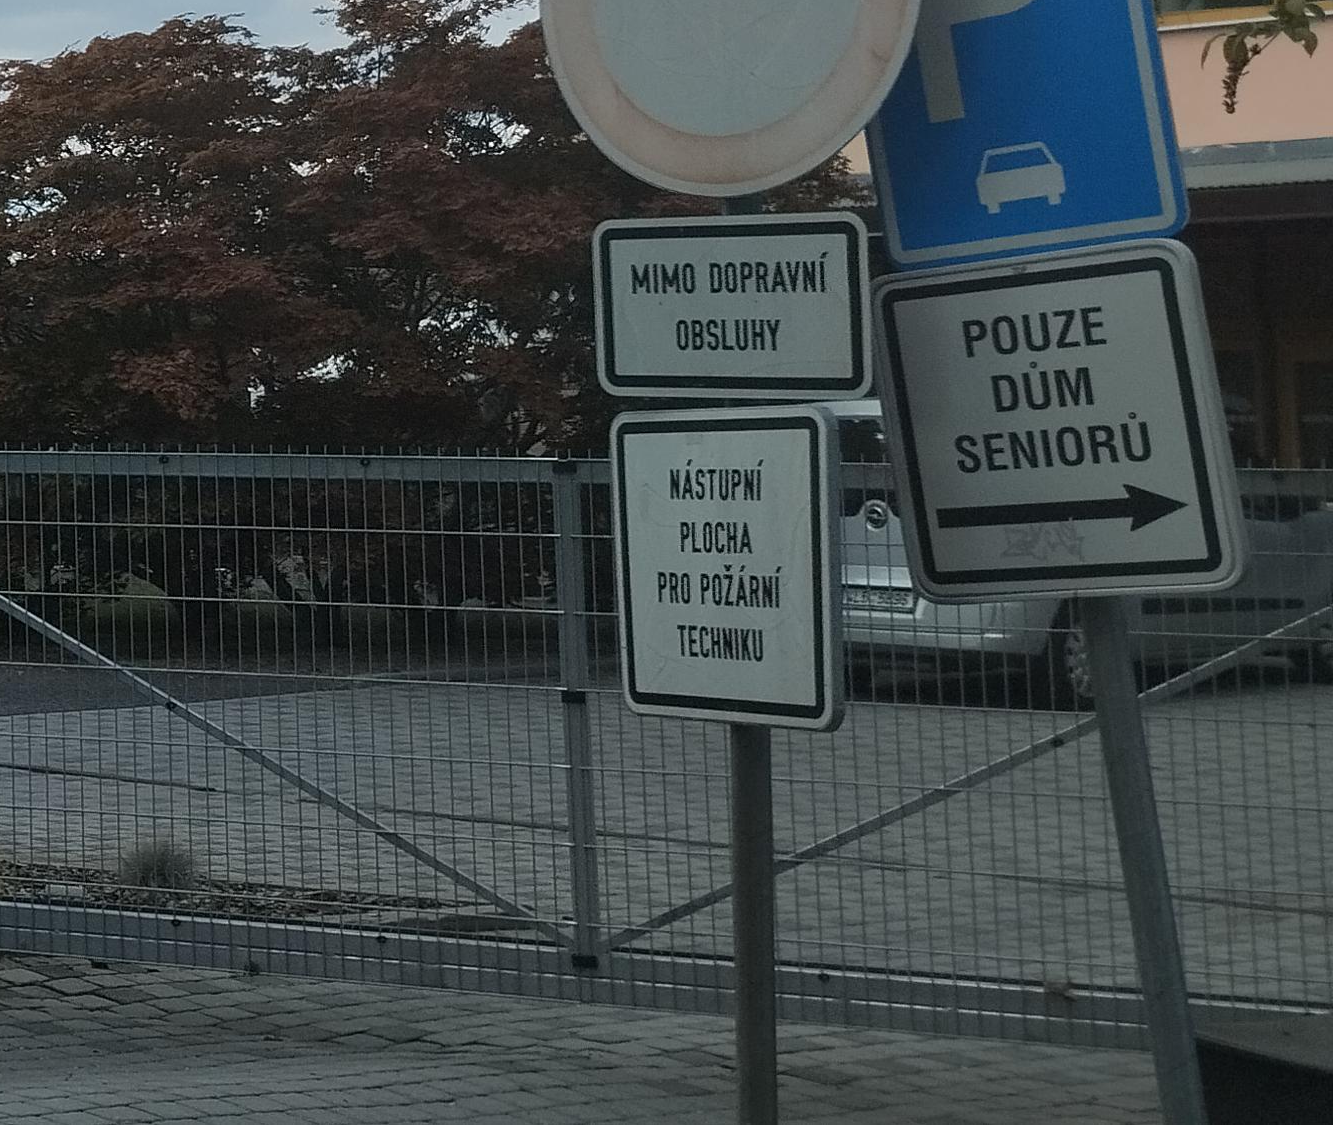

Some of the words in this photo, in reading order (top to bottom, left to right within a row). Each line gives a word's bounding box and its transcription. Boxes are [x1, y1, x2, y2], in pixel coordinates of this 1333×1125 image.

[631, 262, 696, 295] MIMO
[709, 251, 829, 293] DOPRAVNÍ
[675, 319, 781, 351] OBSLUHY
[961, 306, 1108, 358] POUZE
[990, 361, 1095, 413] DŮM
[954, 412, 1152, 474] SENIORŮ
[669, 459, 764, 501] NÁSTUPNÍ
[679, 522, 753, 554] PLOCHA
[657, 571, 691, 604] PRO
[700, 564, 782, 609] POŽÁRNÍ
[677, 625, 763, 662] TECHNIKU
